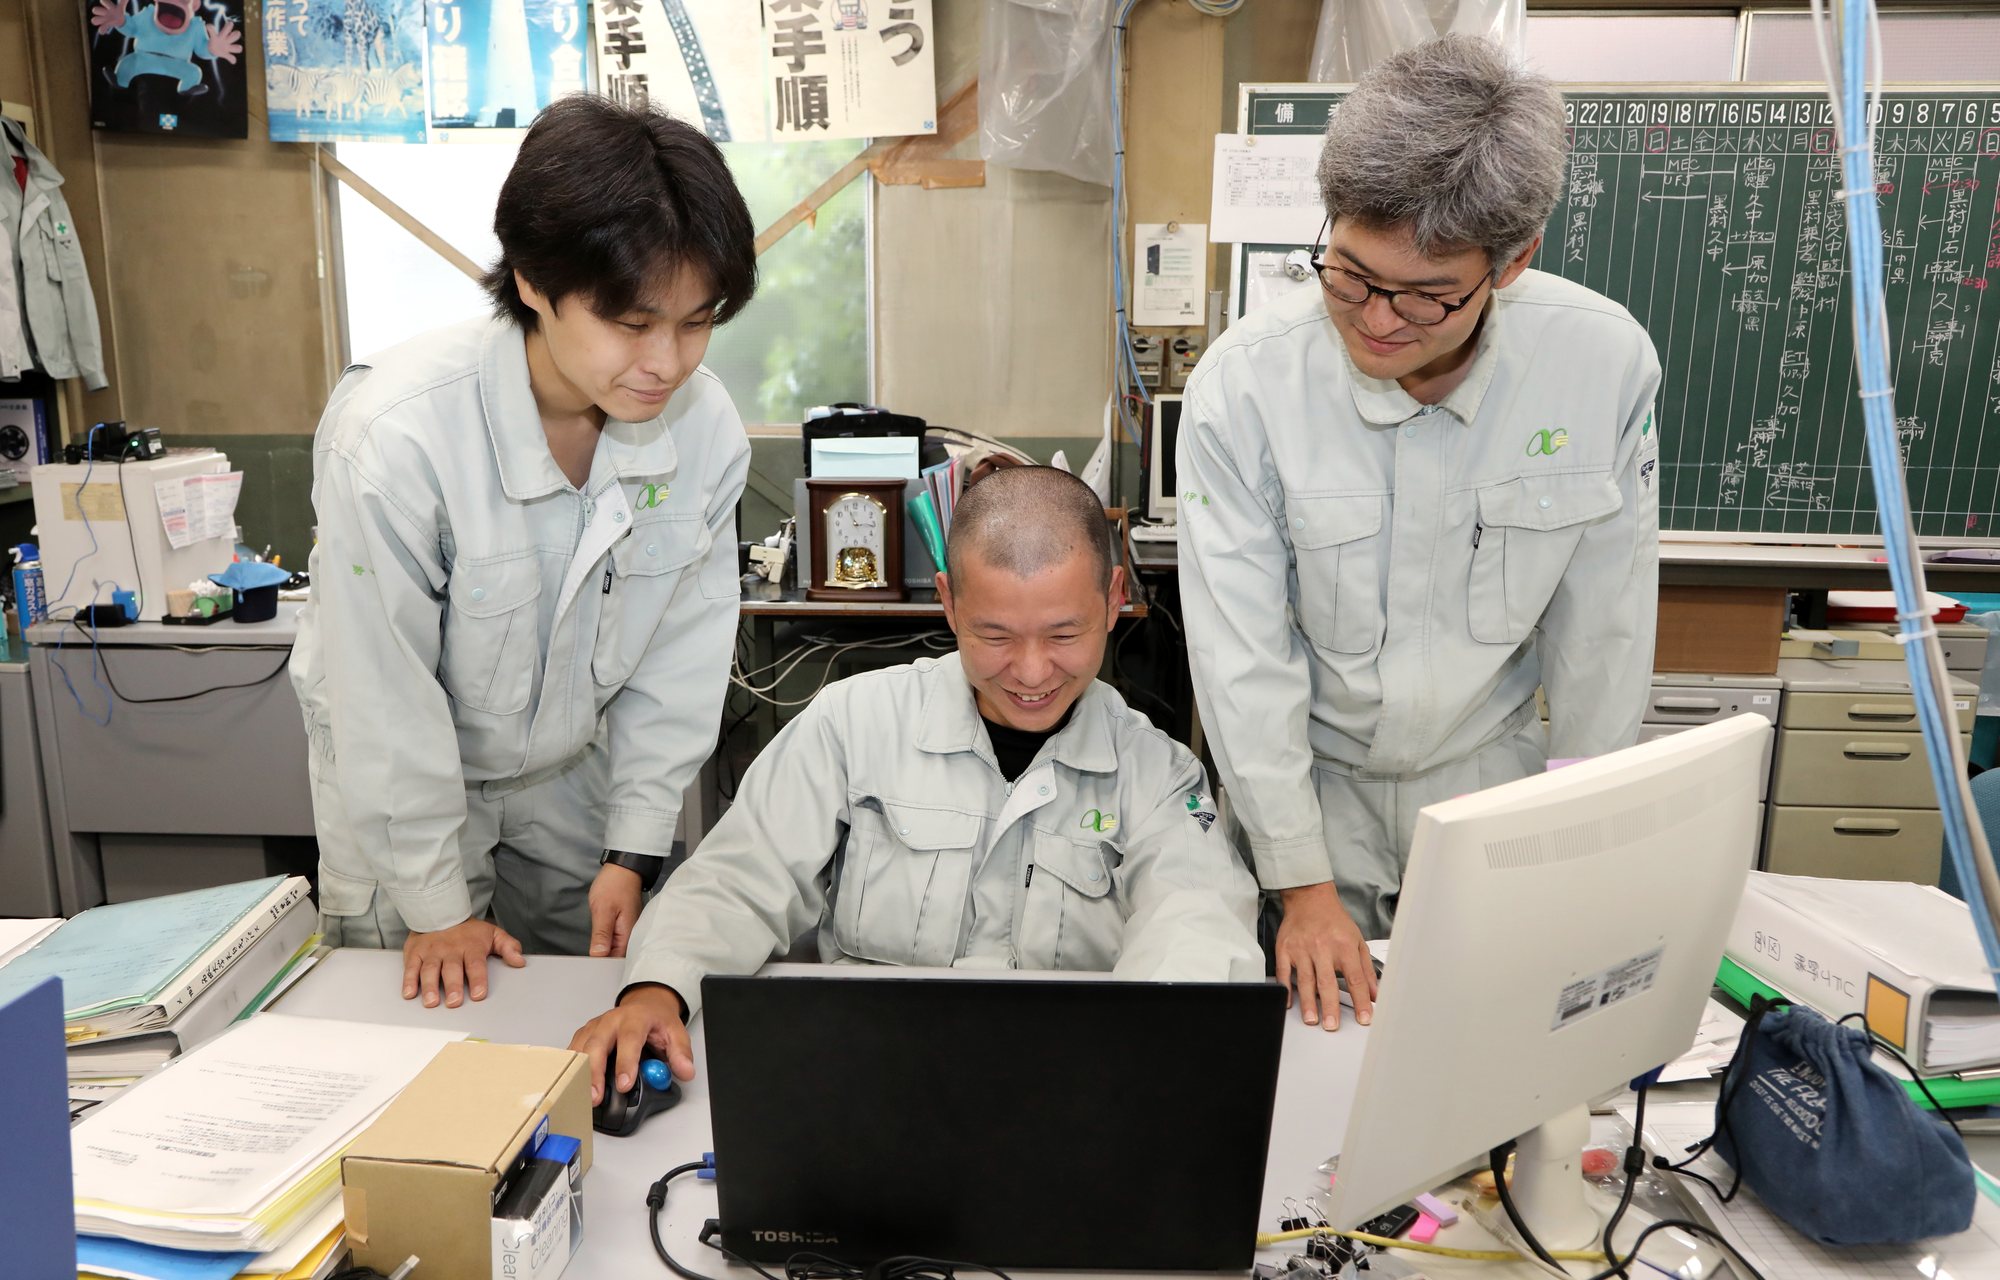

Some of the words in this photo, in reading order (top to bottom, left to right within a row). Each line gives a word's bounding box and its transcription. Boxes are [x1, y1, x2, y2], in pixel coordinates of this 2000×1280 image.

[266, 0, 288, 56] 作業
[879, 0, 925, 67] う
[1565, 103, 1575, 124] 3
[1579, 103, 1599, 124] 22
[1603, 103, 1621, 124] 21
[1627, 103, 1646, 124] 20
[1651, 103, 1668, 124] 19
[1675, 103, 1691, 124] 18
[1698, 103, 1717, 124] 17
[1722, 103, 1739, 124] 16
[1745, 103, 1763, 124] 15
[1769, 103, 1787, 124] 14
[1794, 103, 1811, 124] 13
[1818, 103, 1834, 124] 12
[1892, 103, 1905, 124] 9
[1916, 103, 1929, 124] 8
[1941, 103, 1956, 124] 7
[1965, 103, 1978, 124] 6
[1990, 103, 2000, 124] 5
[1575, 130, 1598, 149] 水
[1602, 130, 1619, 150] 火
[1625, 129, 1638, 151] 月
[1649, 131, 1664, 151] 日
[1671, 136, 1689, 151] 土
[1692, 129, 1716, 152] 金
[1715, 129, 1737, 152] 木
[1742, 130, 1762, 152] 水
[1765, 133, 1783, 152] 火
[1792, 132, 1809, 151] 月
[1815, 134, 1829, 151] 日
[1884, 133, 1906, 153] 木
[1909, 134, 1928, 152] 水
[1933, 130, 1953, 153] 火
[1957, 130, 1976, 152] 月
[1985, 132, 2000, 153] 日
[1668, 159, 1700, 171] MEC
[1745, 157, 1773, 168] MEC
[1931, 156, 1964, 168] MEC
[1664, 175, 1694, 187] UFJ
[1928, 171, 1964, 183] UFJ
